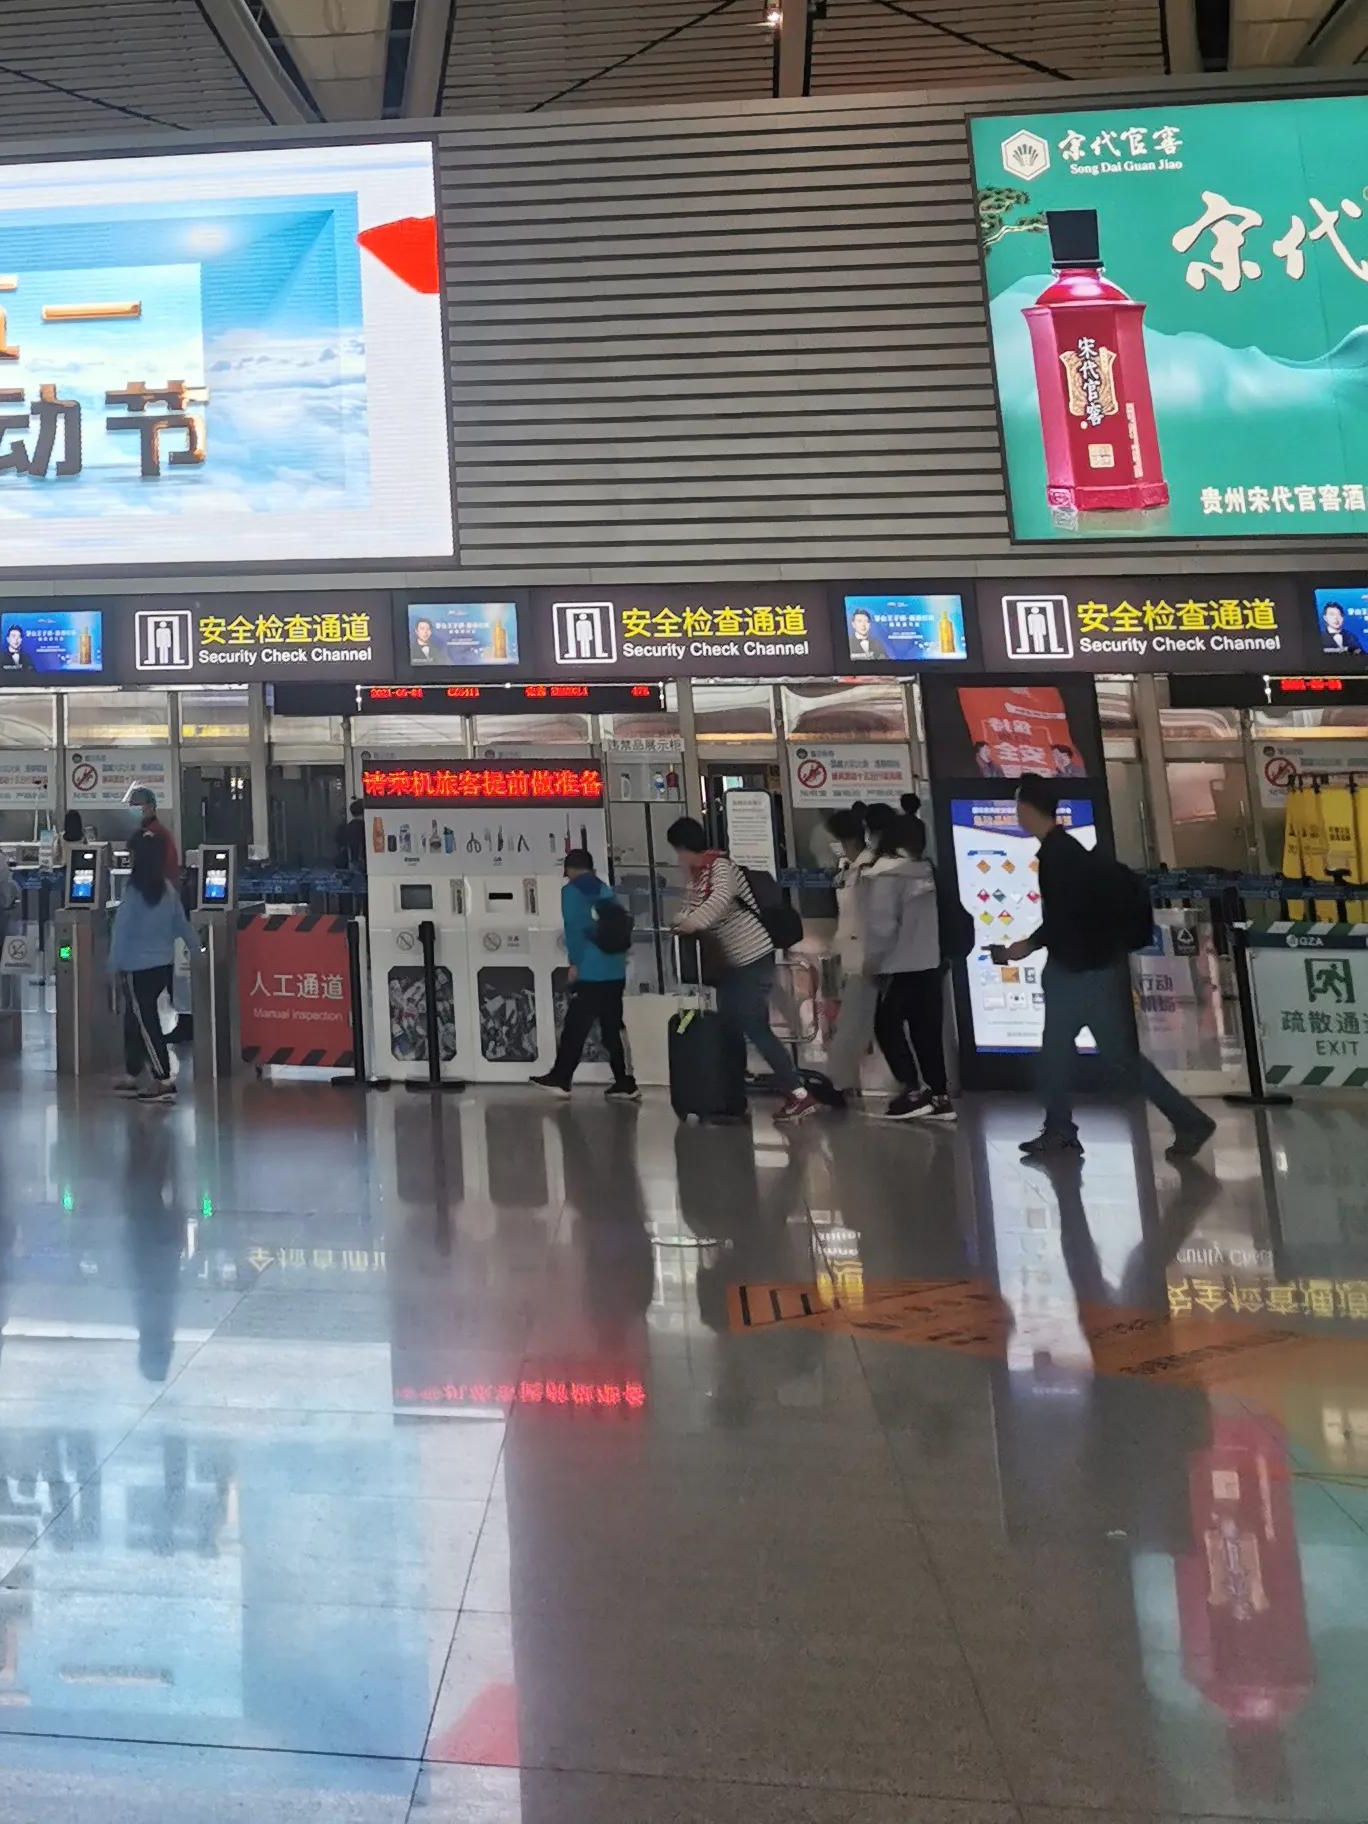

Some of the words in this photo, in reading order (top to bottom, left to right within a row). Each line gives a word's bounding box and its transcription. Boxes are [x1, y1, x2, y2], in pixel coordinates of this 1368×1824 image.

[1070, 162, 1099, 176] Song
[1101, 161, 1122, 173] Dai
[1124, 161, 1156, 172] Guan
[1158, 158, 1183, 171] Jiao
[622, 605, 807, 639] 安全检查通道
[1077, 598, 1278, 633] 安全检查通道
[199, 613, 371, 645] 安全检查通道
[623, 644, 685, 660] Security
[689, 642, 740, 657] Check
[744, 641, 809, 656] Channel
[1079, 637, 1147, 655] Security
[1152, 636, 1206, 651] Check
[1210, 635, 1281, 651] Channel
[198, 649, 258, 665] Security
[261, 648, 307, 663] Check
[311, 647, 372, 662] Channel
[363, 768, 603, 798] 请乘机旅客提前做准备
[1299, 936, 1324, 946] GZA
[249, 971, 344, 1000] 人工通道
[253, 1007, 290, 1019] Manual
[1280, 1009, 1368, 1035] 疏散通
[1316, 1040, 1359, 1056] EXIT
